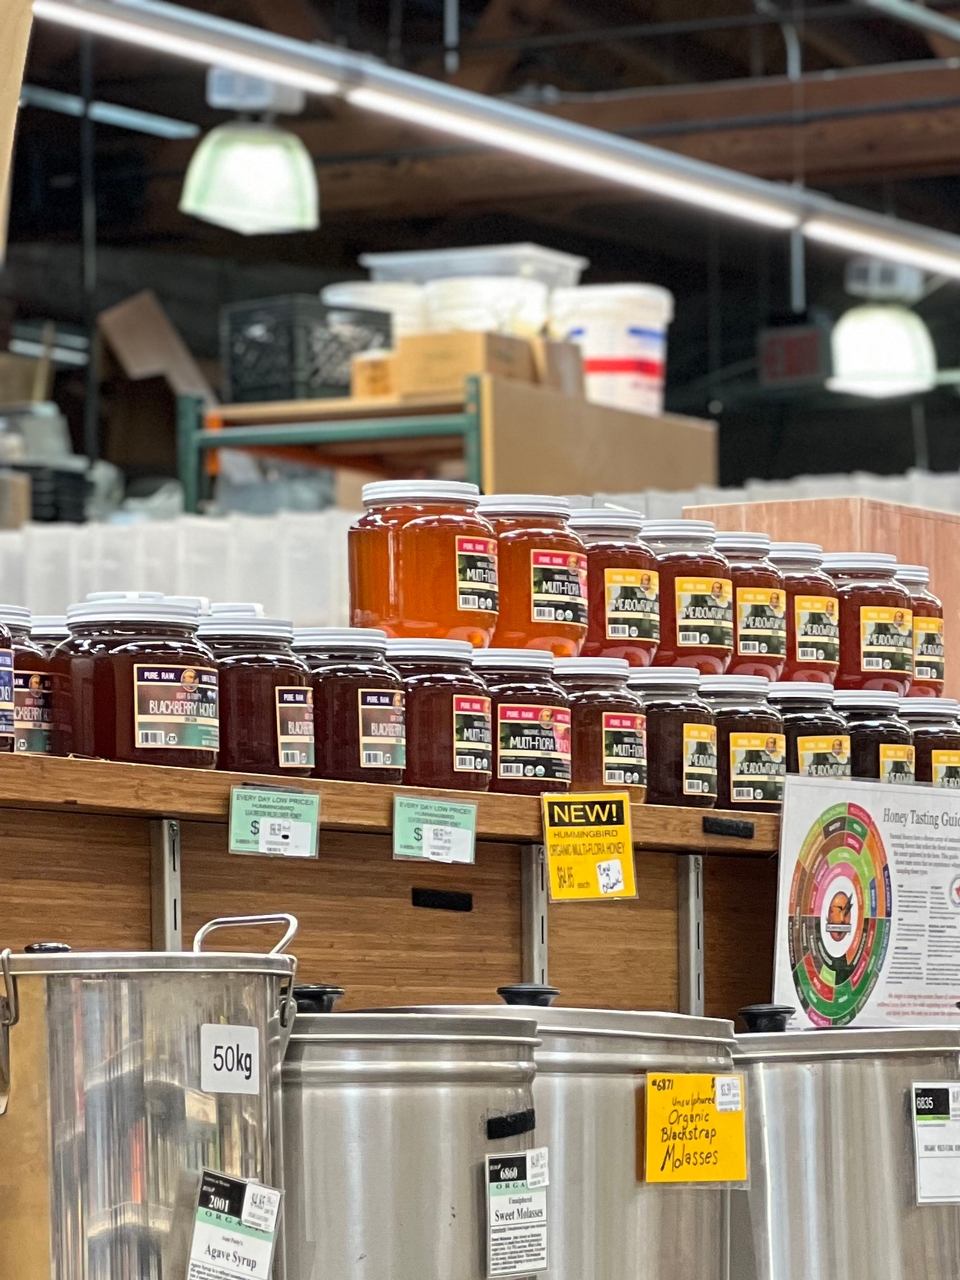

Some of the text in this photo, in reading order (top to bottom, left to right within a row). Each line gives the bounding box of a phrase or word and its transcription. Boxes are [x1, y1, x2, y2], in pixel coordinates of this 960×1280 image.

[144, 671, 160, 680] PURE.
[161, 672, 176, 680] RAW.
[149, 699, 198, 715] BLACKBERRY
[257, 795, 271, 803] DAY
[420, 803, 433, 811] DAY
[553, 803, 618, 823] NEW!
[882, 808, 909, 827] Honey
[910, 809, 940, 829] Tasting
[553, 829, 618, 839] HUMMINGBIRD
[213, 1044, 252, 1080] 50kg
[651, 1079, 674, 1092] #6871
[672, 1090, 716, 1112] Unsulphured
[916, 1096, 934, 1109] 6835
[668, 1109, 710, 1130] Organic
[661, 1124, 717, 1145] Blackstrap
[660, 1143, 718, 1173] Molasses
[500, 1166, 518, 1180] 6860
[496, 1182, 526, 1190] ORGA
[208, 1195, 230, 1213] 2001
[494, 1206, 544, 1222] Sweet Molasses
[204, 1244, 257, 1271] Agave Syrup
